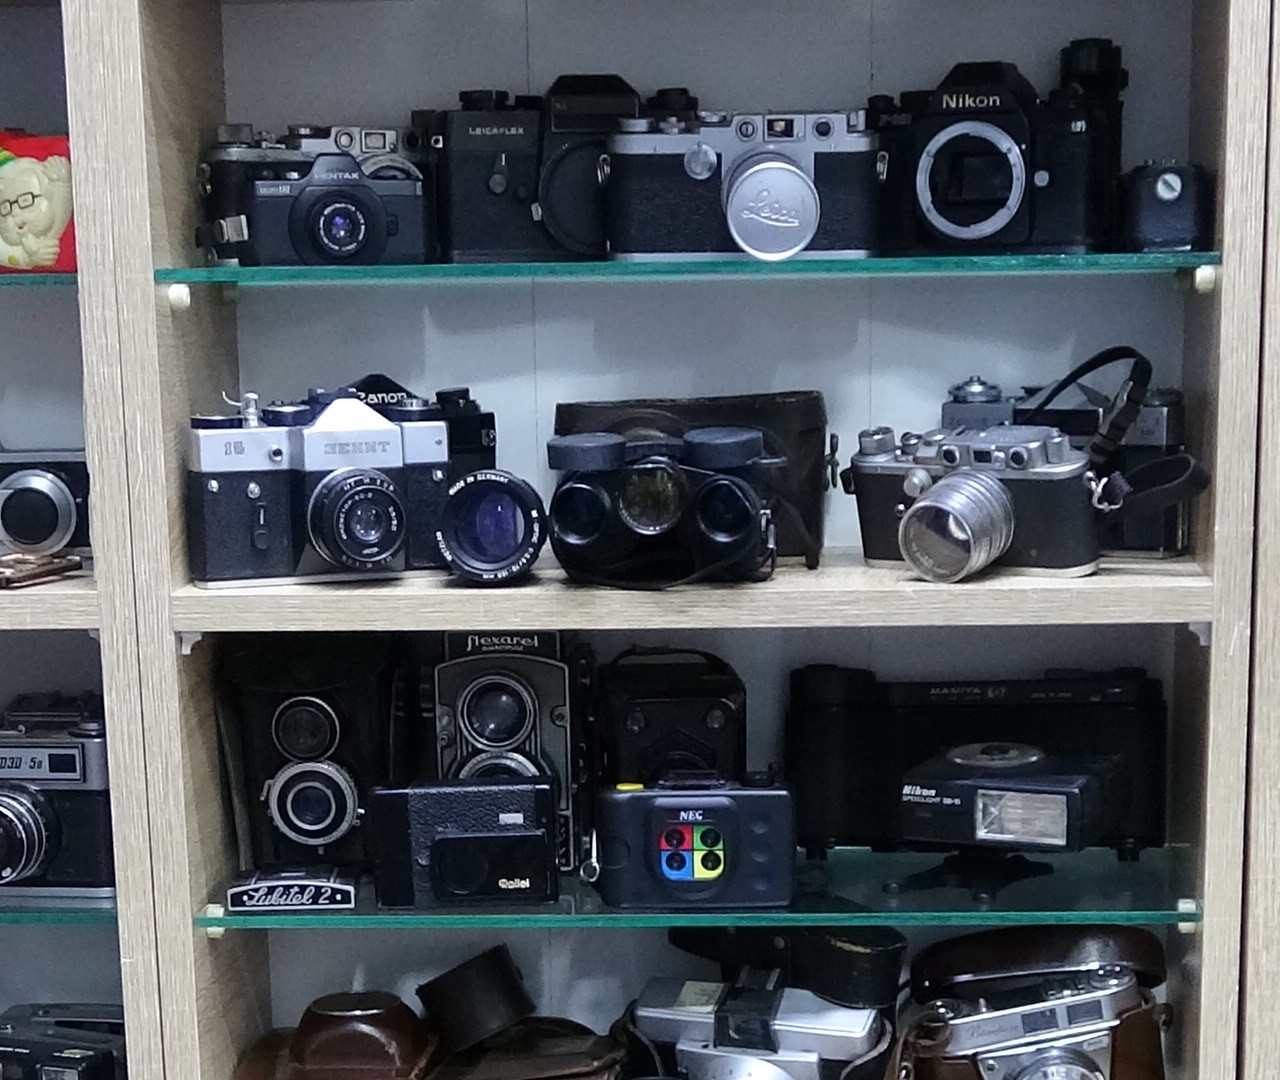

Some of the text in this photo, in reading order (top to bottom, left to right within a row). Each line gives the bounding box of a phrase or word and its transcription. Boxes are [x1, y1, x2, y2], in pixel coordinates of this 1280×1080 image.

[941, 93, 1001, 109] Nikon
[468, 125, 525, 135] LEICAFLEX
[902, 785, 937, 797] Nikon
[679, 810, 704, 821] NEC
[246, 886, 332, 906] Lubitel 2
